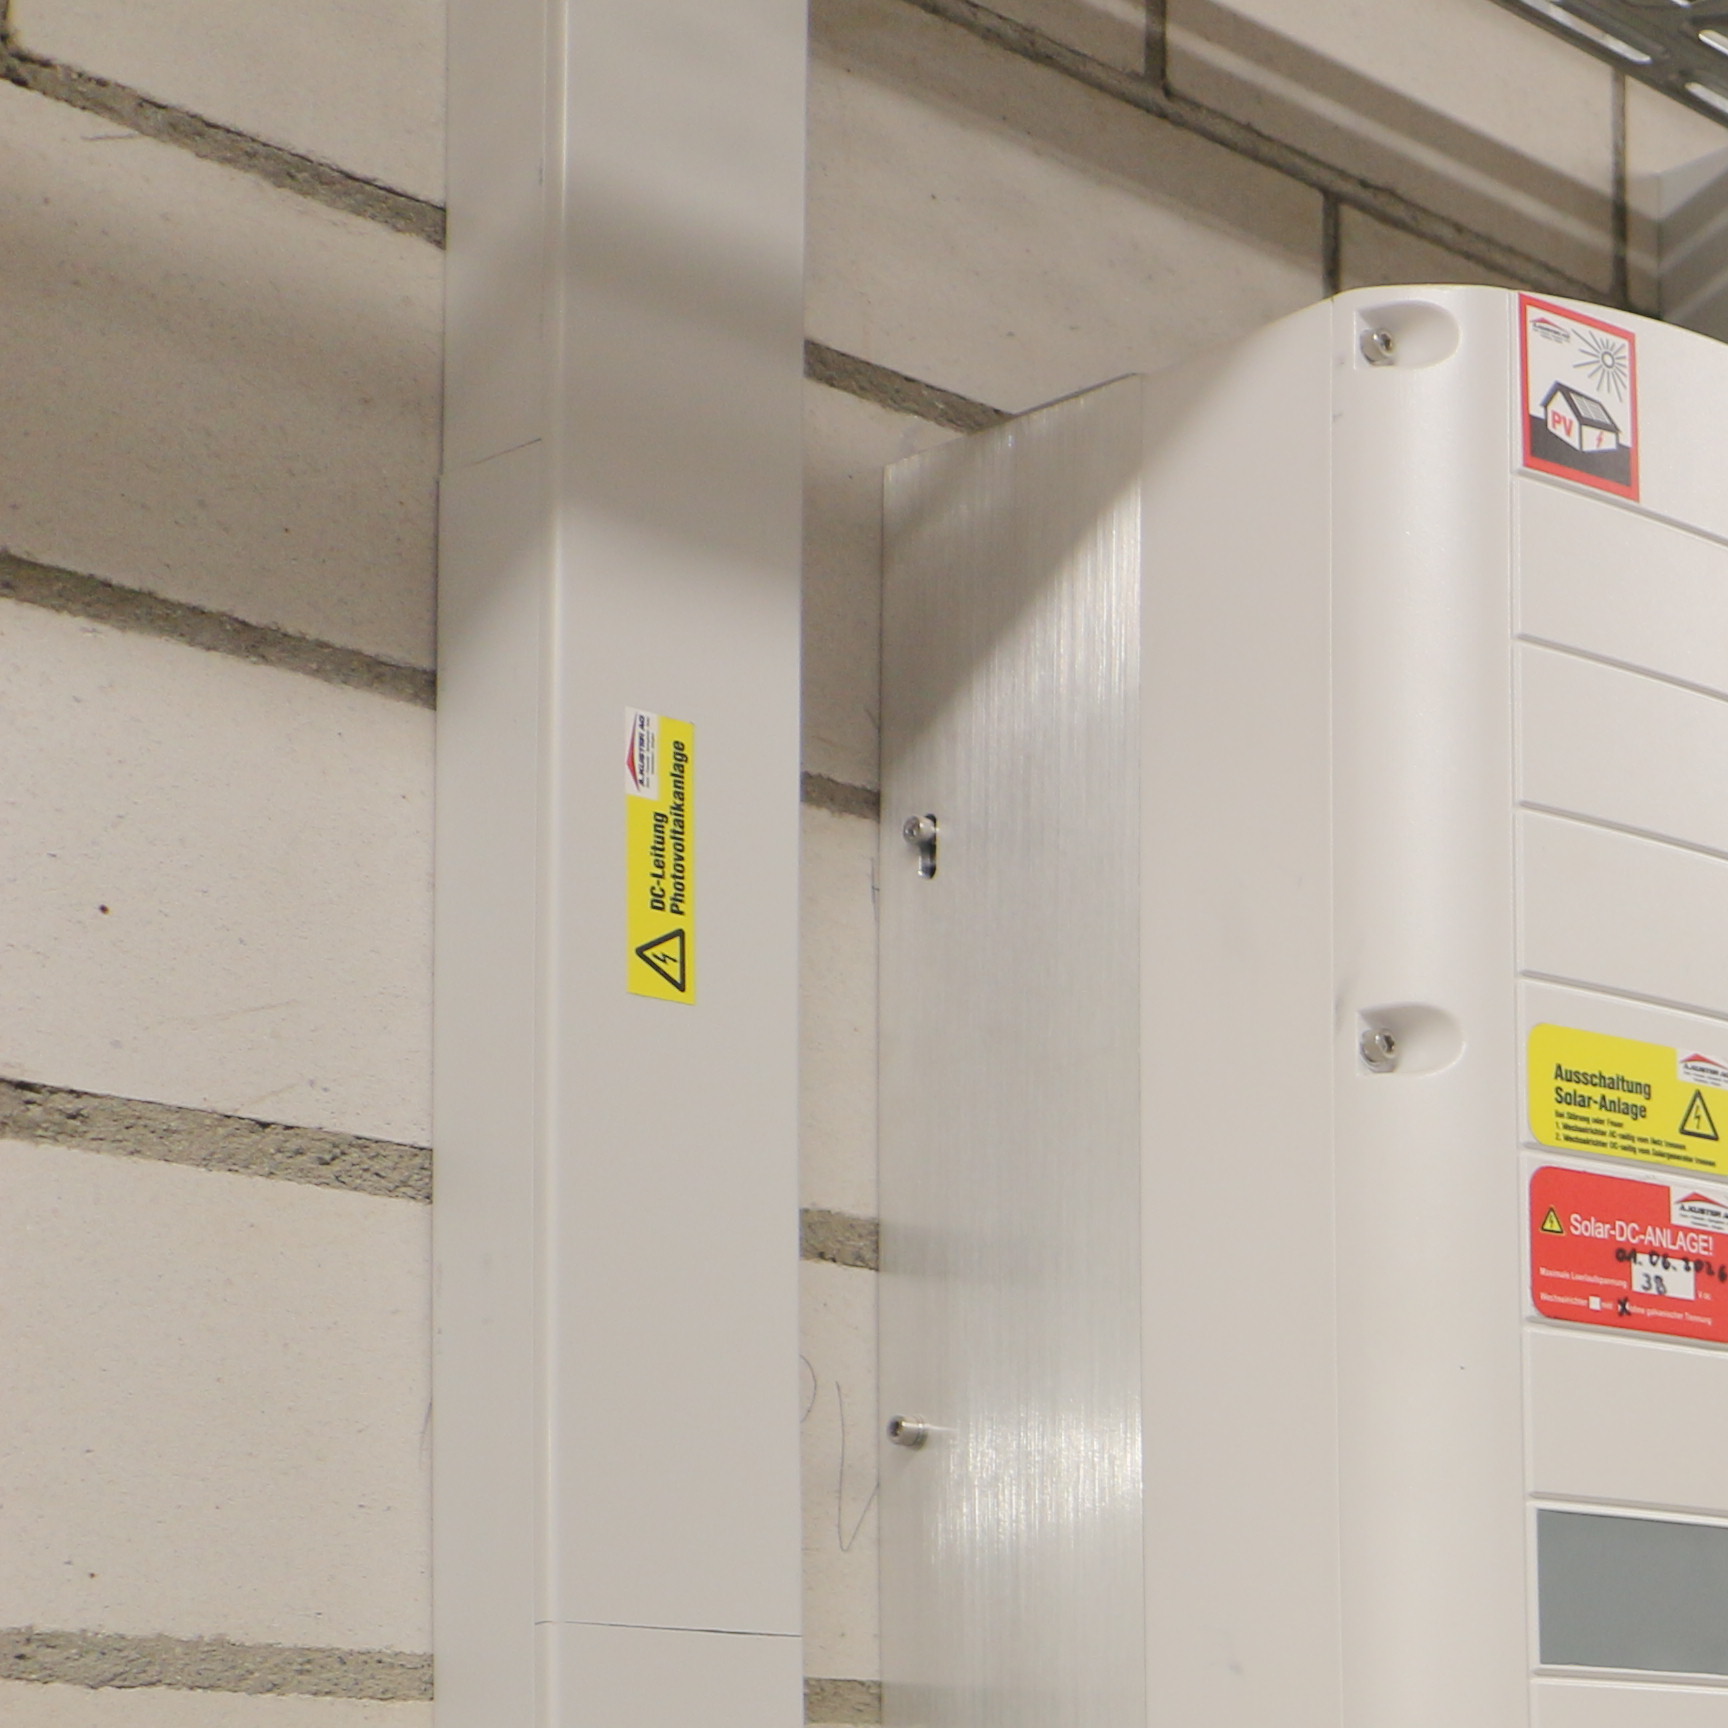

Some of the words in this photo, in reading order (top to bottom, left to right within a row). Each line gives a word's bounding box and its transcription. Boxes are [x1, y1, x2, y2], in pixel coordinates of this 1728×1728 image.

[1551, 410, 1574, 437] PV
[669, 740, 688, 915] Photovoltaikanlage
[649, 811, 668, 911] DC-Leitung
[1554, 1063, 1651, 1100] Ausschaltung
[1554, 1086, 1647, 1121] Solar-Anlage
[1570, 1213, 1714, 1256] Solar-DC-ANLAGE!
[1641, 1272, 1667, 1295] 38
